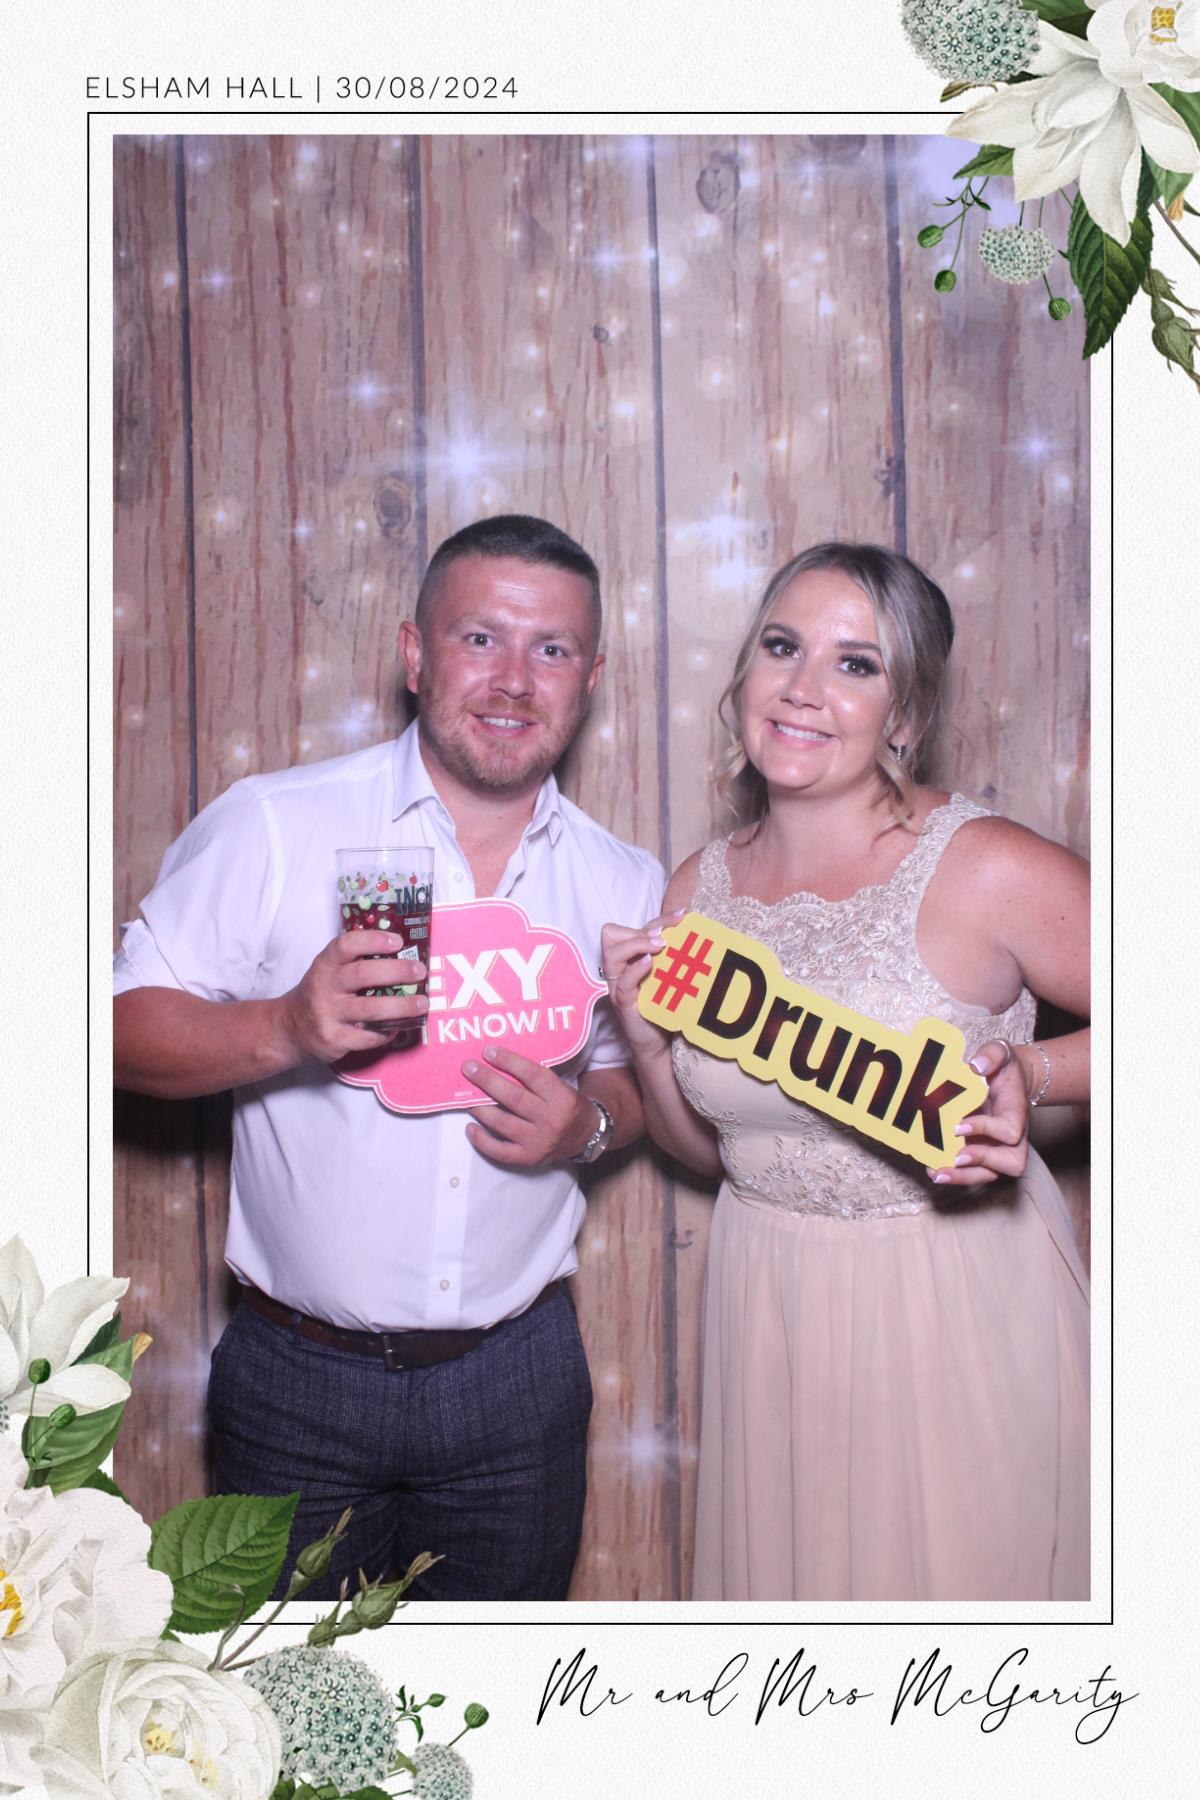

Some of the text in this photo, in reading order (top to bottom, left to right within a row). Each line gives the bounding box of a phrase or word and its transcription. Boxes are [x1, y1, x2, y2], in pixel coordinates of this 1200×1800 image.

[428, 943, 555, 1012] EXY
[437, 1008, 540, 1045] KNOW
[547, 1005, 574, 1031] IT
[651, 930, 968, 1153] #Drunk
